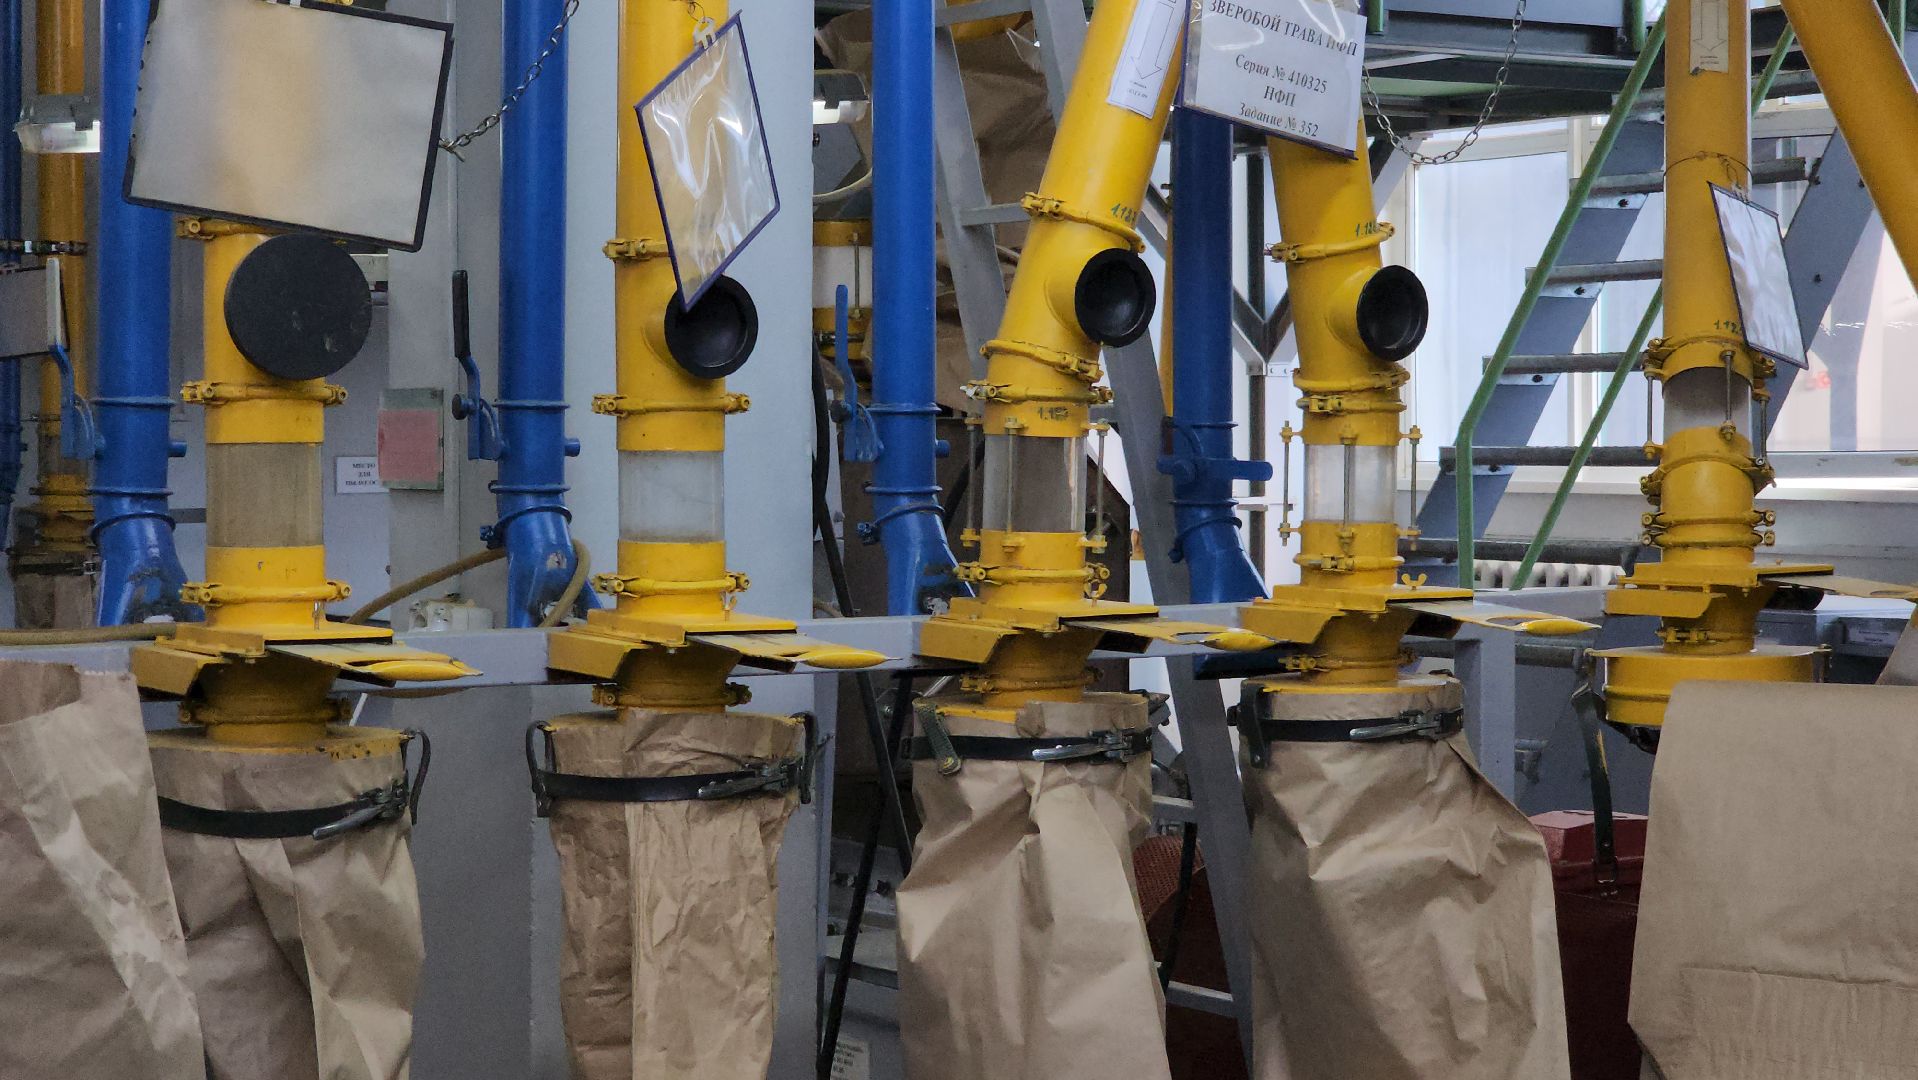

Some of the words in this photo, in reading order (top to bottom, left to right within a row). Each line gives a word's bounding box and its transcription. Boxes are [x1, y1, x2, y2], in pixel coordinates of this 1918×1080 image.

[1209, 0, 1281, 32] ЗВЕРОБОЙ
[1284, 21, 1323, 46] ТРАВА
[1235, 54, 1269, 76] Серия
[1272, 65, 1285, 80] №
[1288, 70, 1328, 94] 410325
[1264, 85, 1296, 107] НФП
[1239, 102, 1283, 127] Задание
[1285, 116, 1297, 130] №
[1299, 120, 1319, 137] 352
